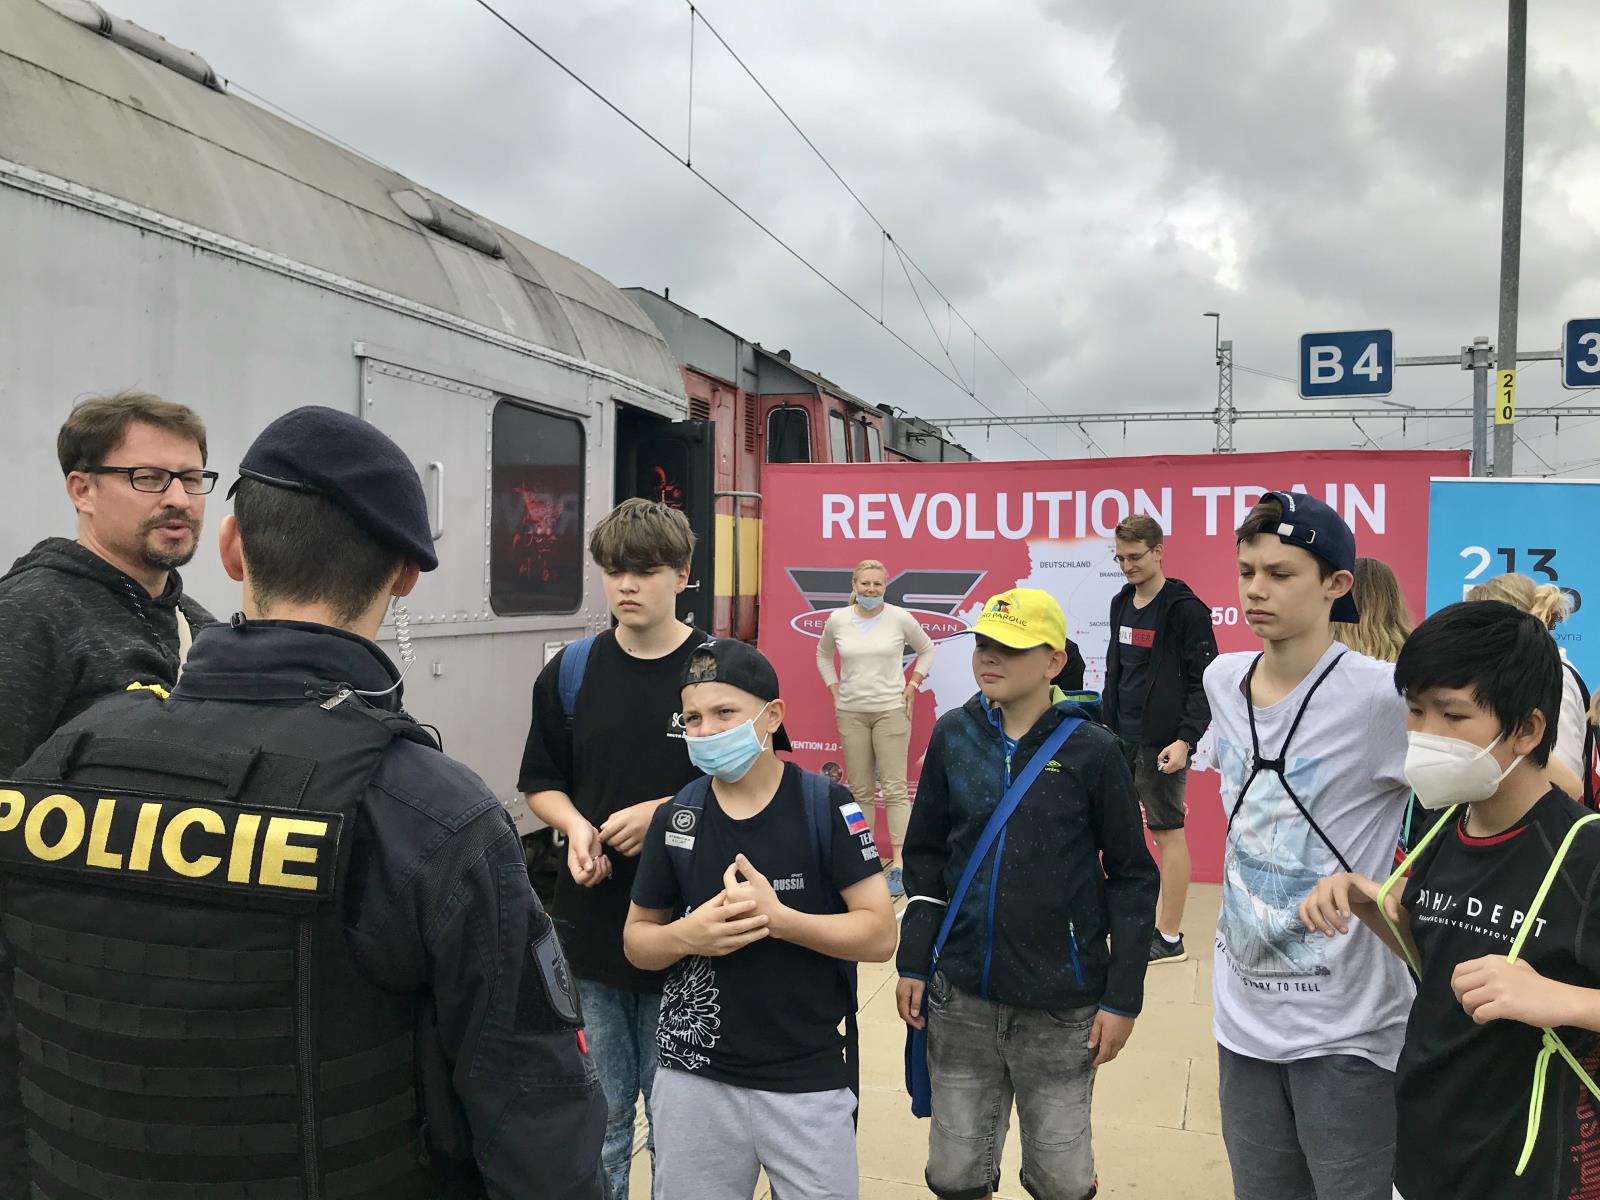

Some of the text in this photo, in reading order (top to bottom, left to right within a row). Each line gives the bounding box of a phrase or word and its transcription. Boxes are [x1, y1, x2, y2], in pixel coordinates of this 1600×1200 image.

[822, 483, 1386, 540] REVOLUTION TRIN
[920, 624, 958, 632] RAIN
[790, 740, 823, 750] VENTION
[773, 878, 805, 891] RUSSIA
[1277, 982, 1289, 991] TO
[1295, 982, 1321, 992] TELL
